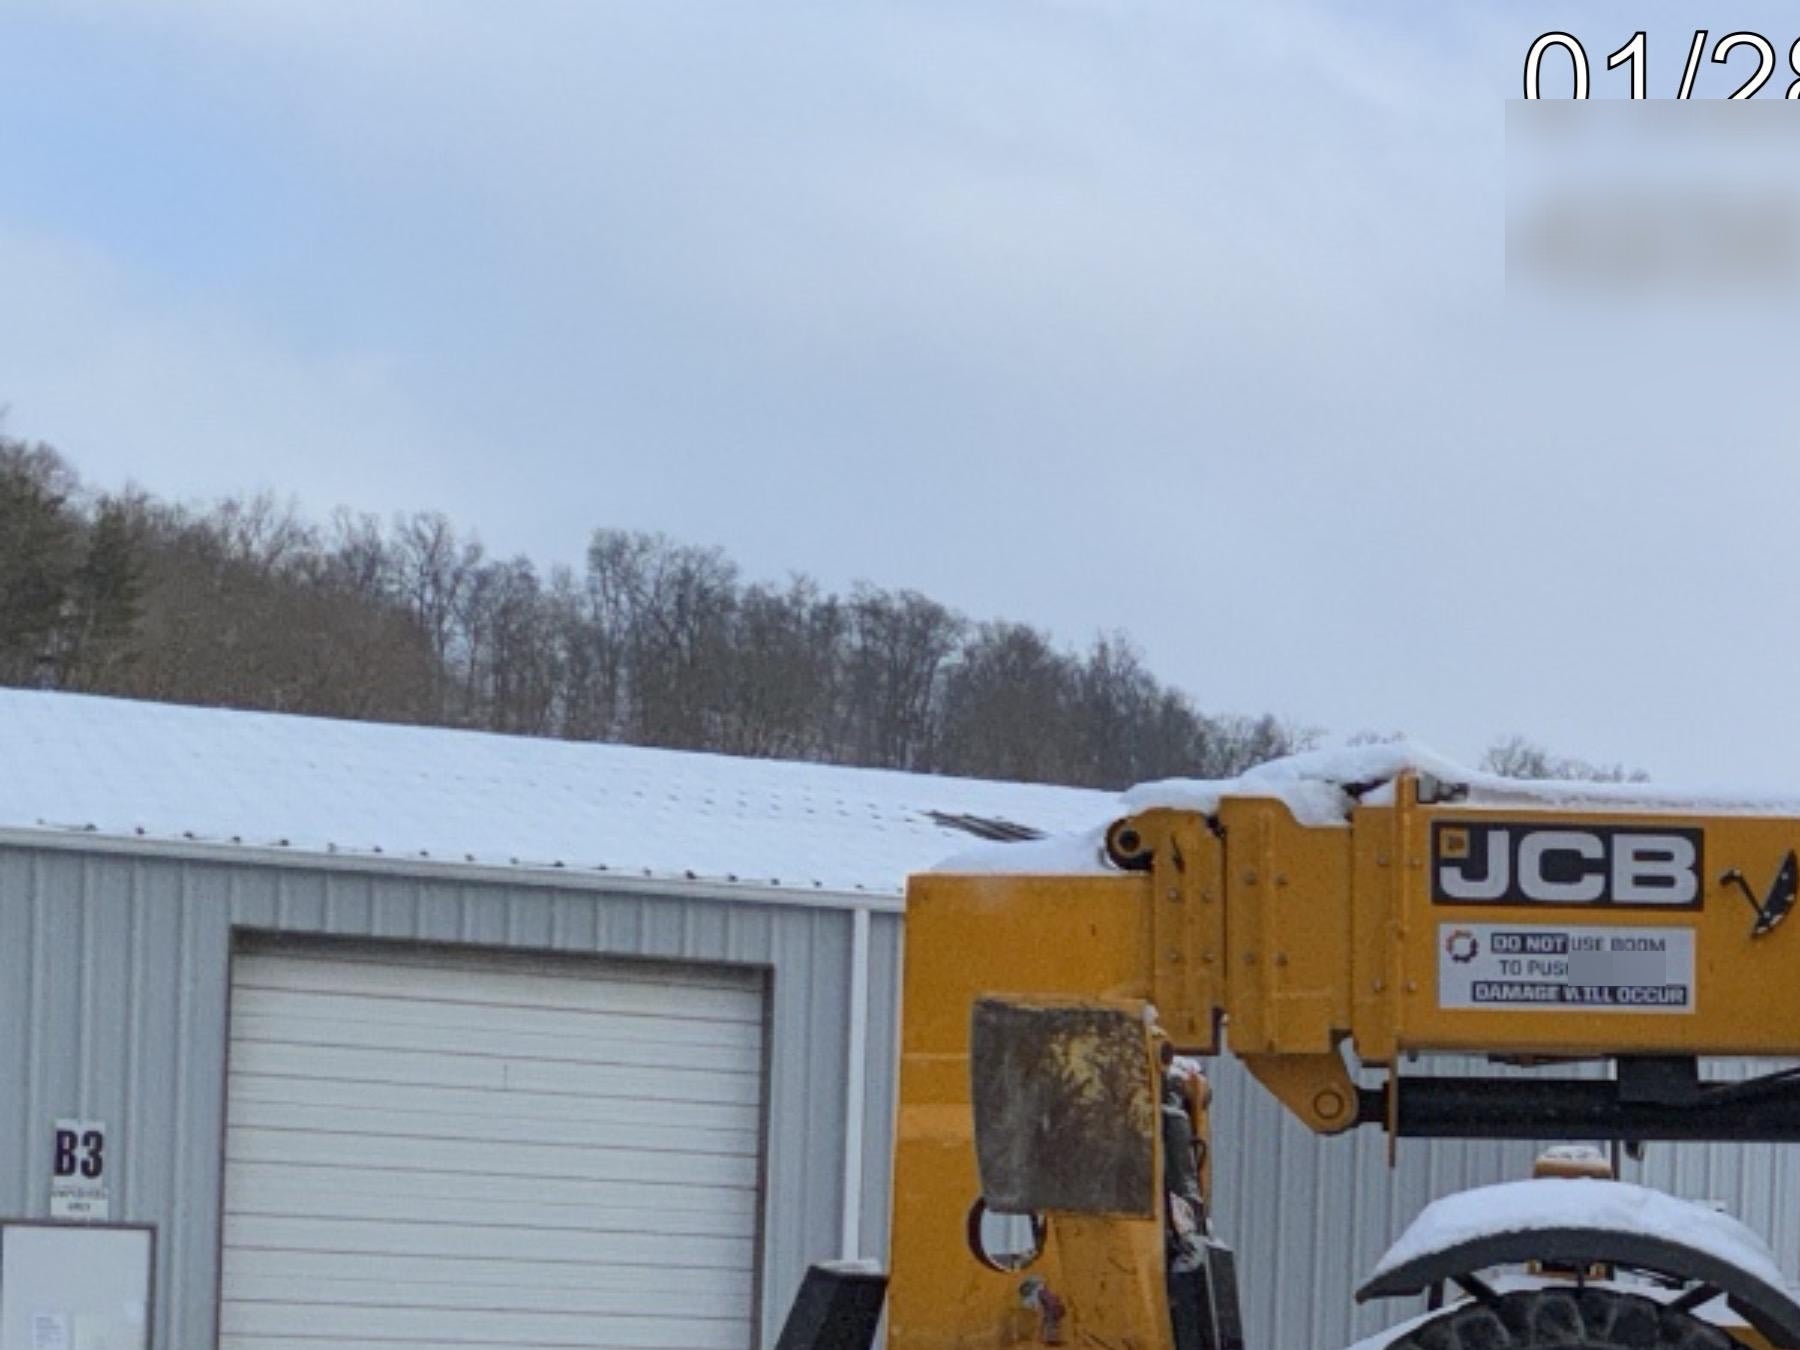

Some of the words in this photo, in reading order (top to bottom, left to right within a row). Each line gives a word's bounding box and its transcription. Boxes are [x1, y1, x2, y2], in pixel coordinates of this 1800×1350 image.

[1440, 830, 1698, 903] JCB
[1494, 935, 1520, 952] DO
[1527, 935, 1567, 952] NOT
[1499, 959, 1522, 976] TO
[1527, 960, 1569, 977] PUS
[1475, 983, 1557, 1001] DAMAGE
[1565, 985, 1613, 1002] WILL
[1616, 985, 1684, 1004] OCCUR
[54, 1130, 104, 1179] B3
